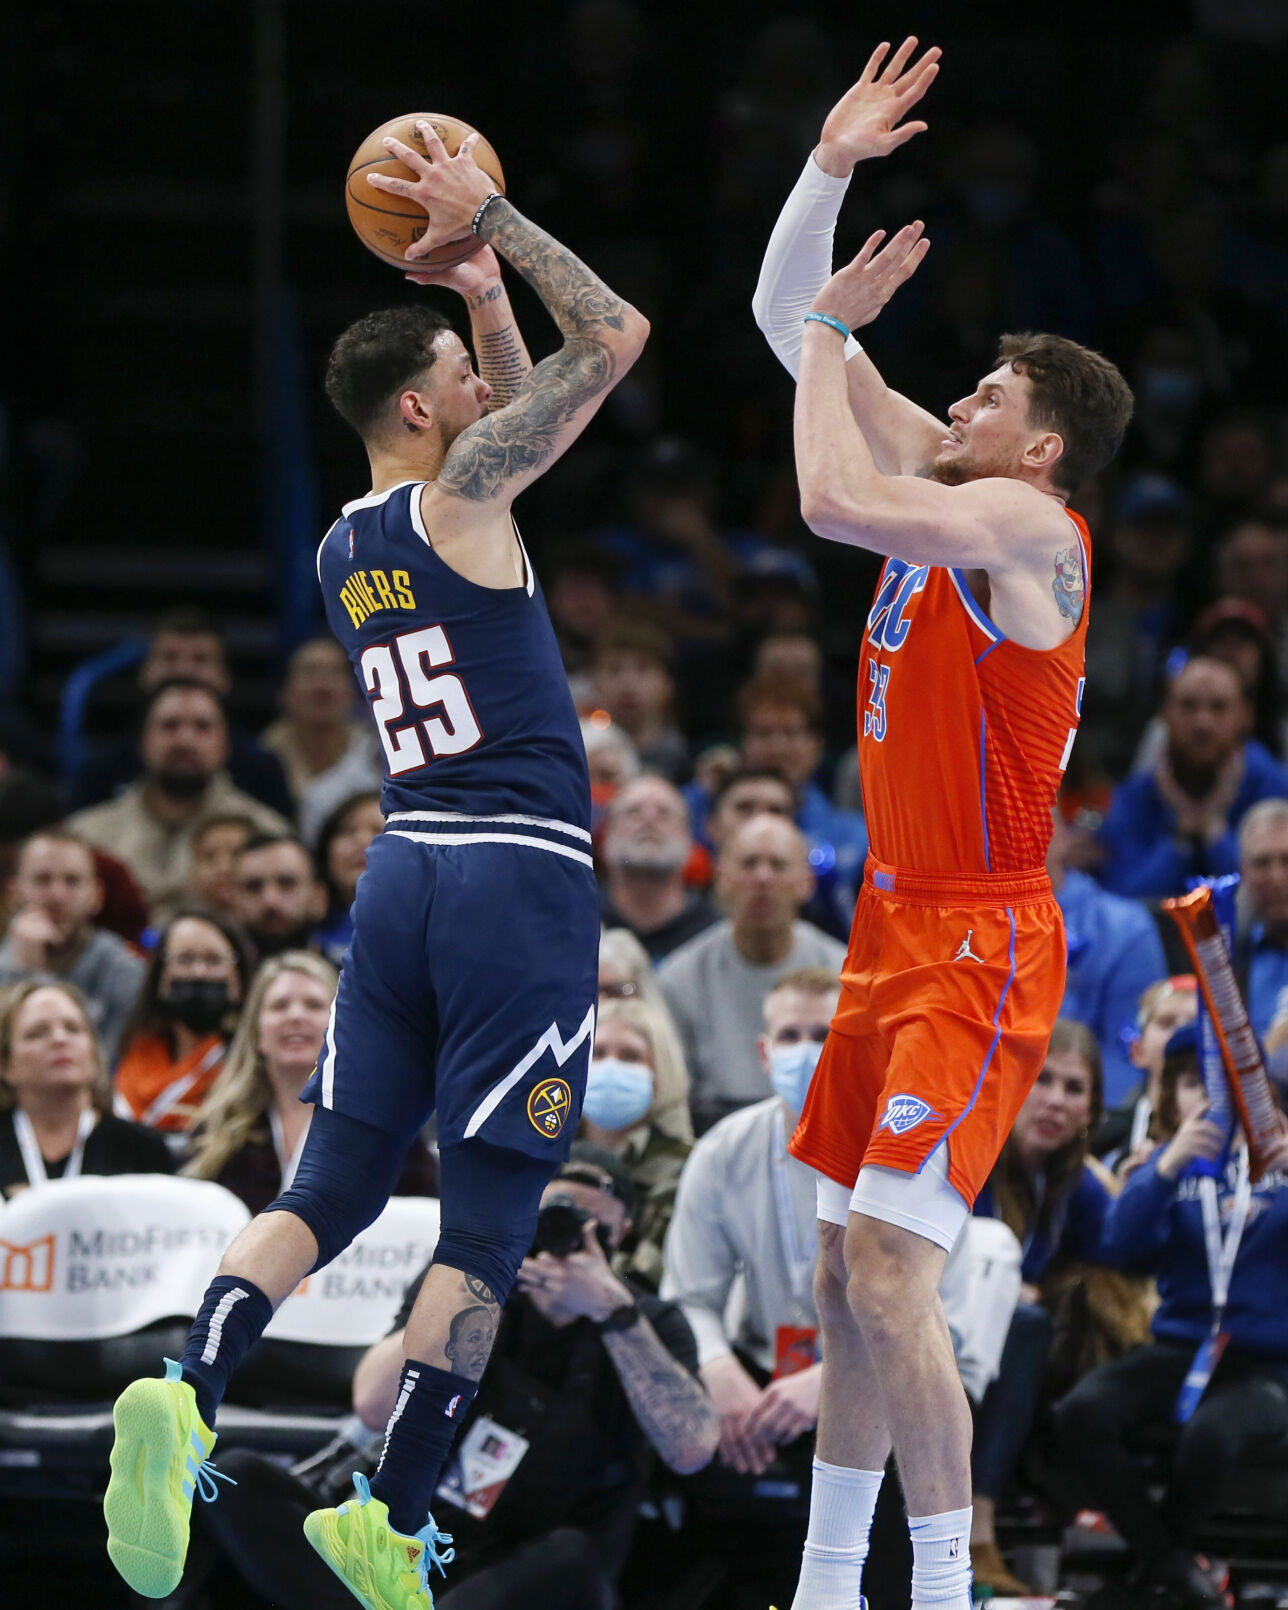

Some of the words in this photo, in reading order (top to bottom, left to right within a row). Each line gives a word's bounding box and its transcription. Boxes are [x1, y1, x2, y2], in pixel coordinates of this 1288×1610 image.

[339, 569, 417, 630] RIVERS
[360, 622, 485, 778] 25
[880, 1104, 920, 1125] OKC
